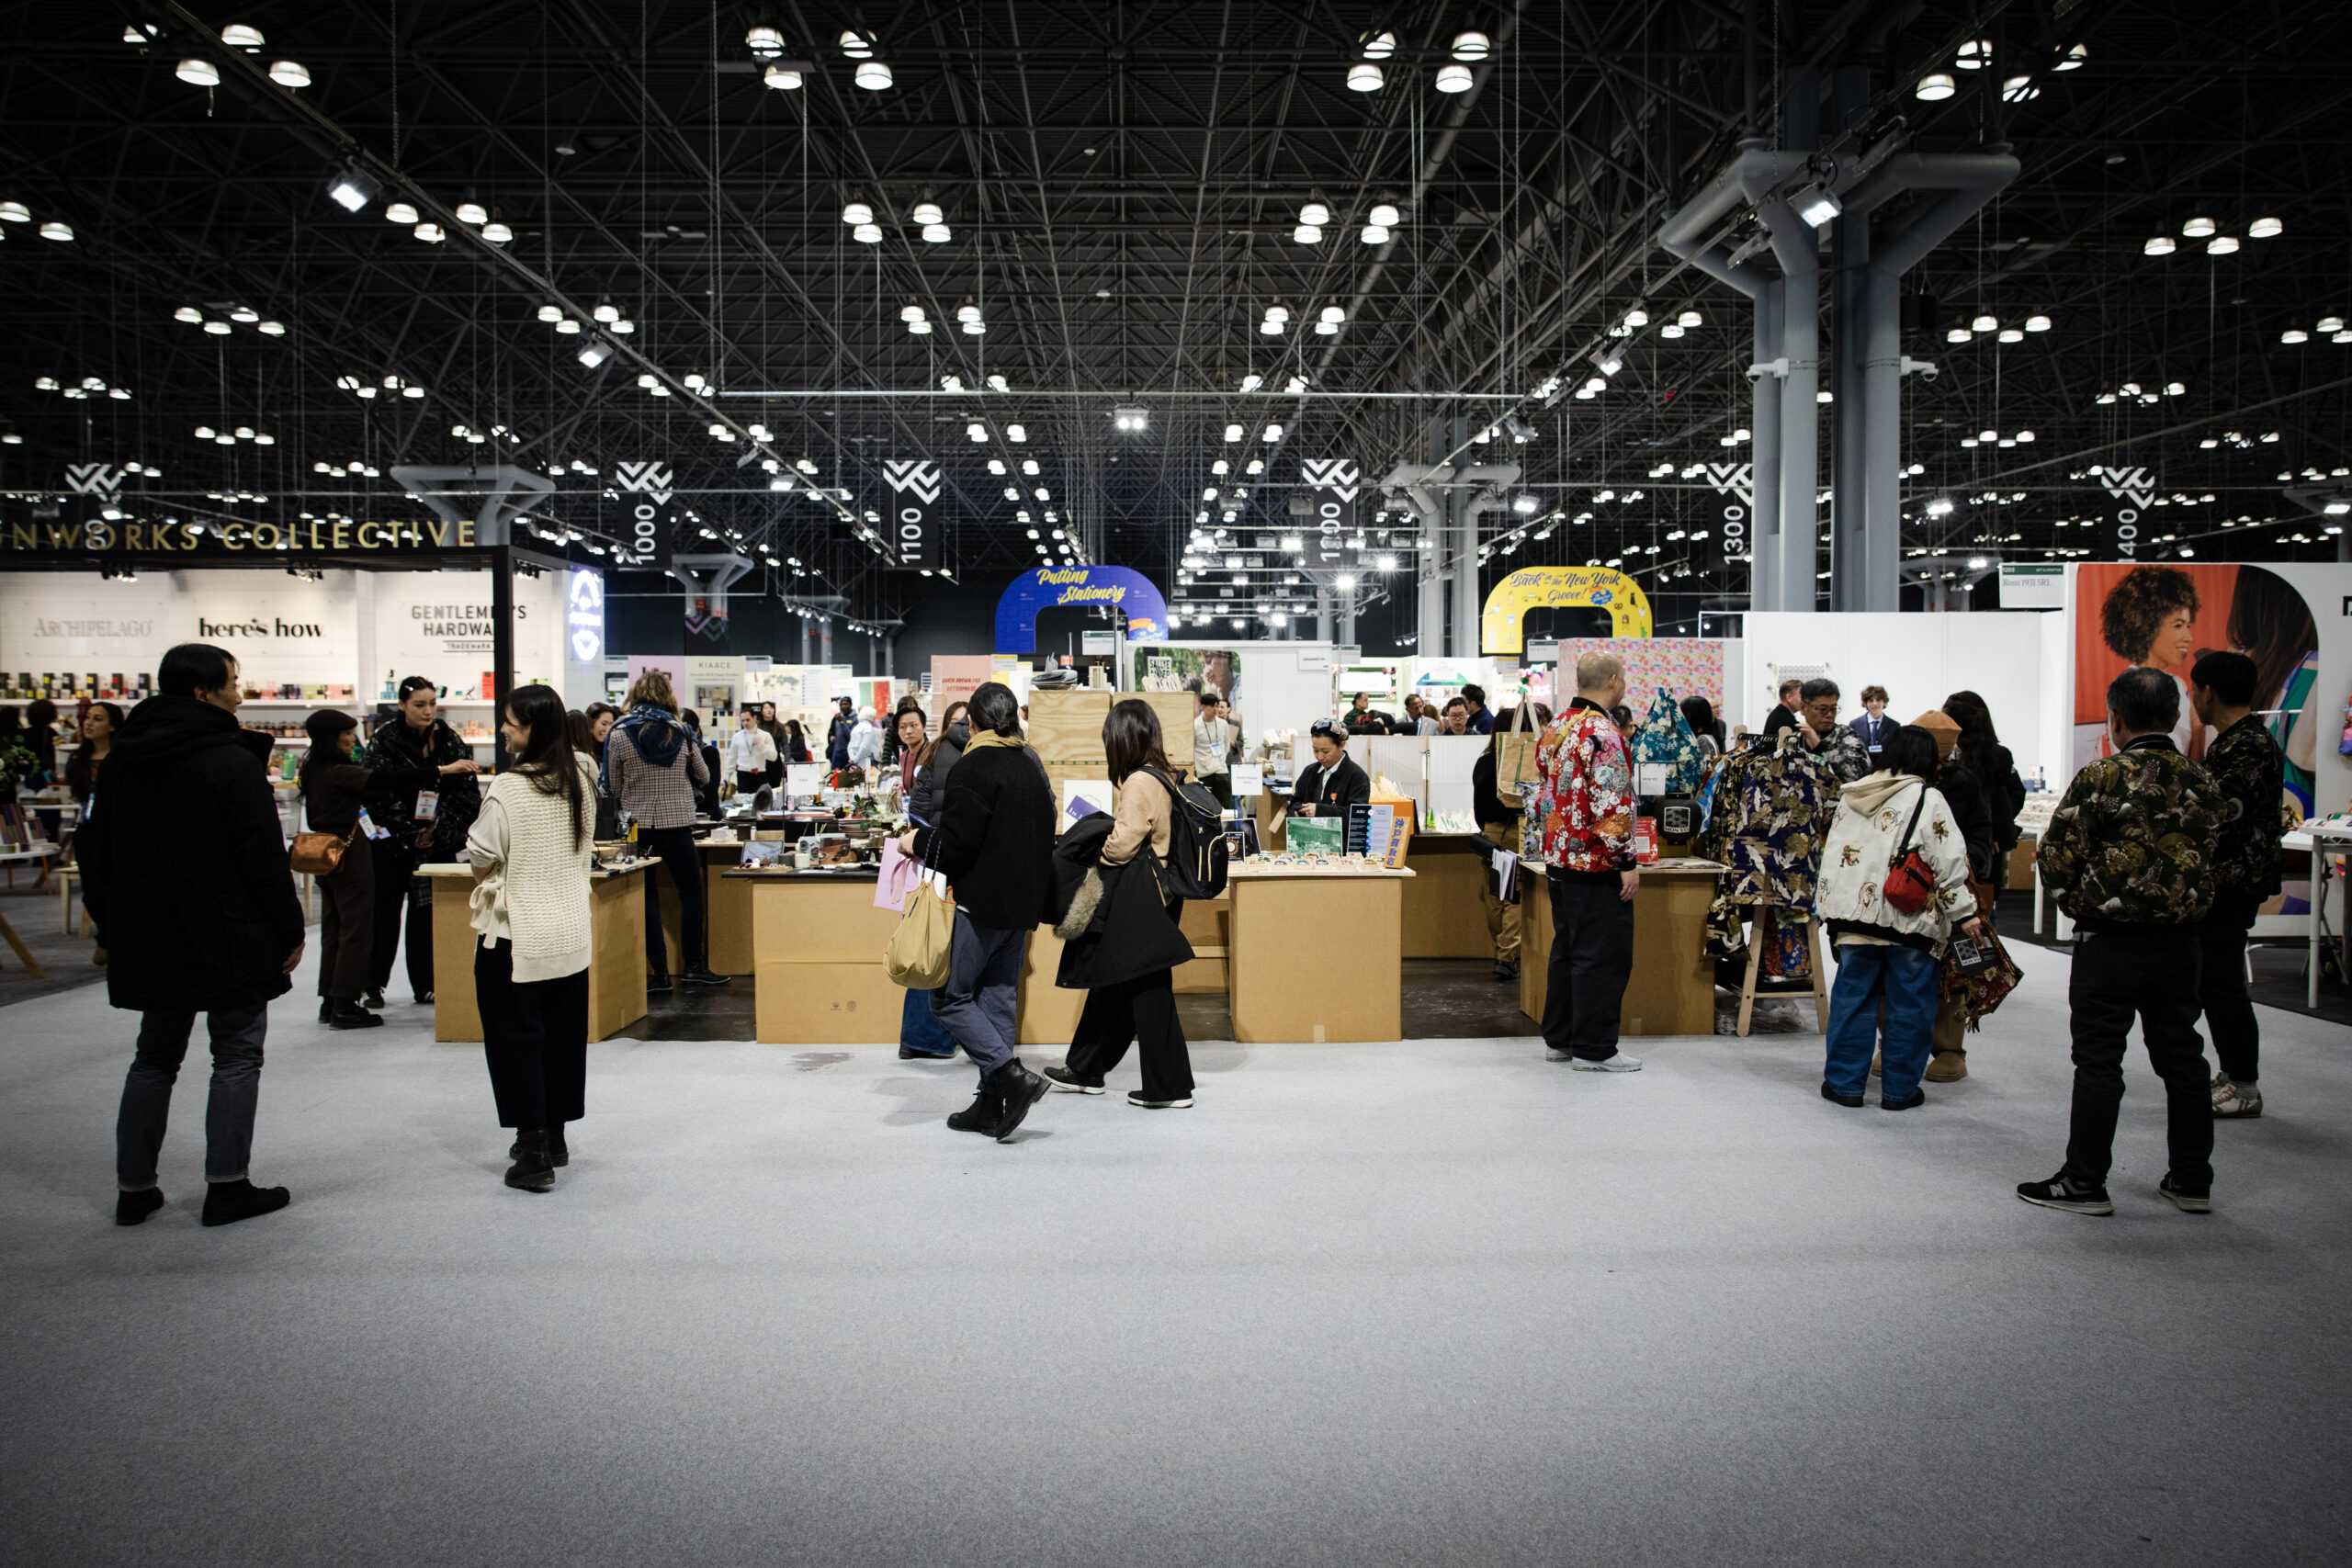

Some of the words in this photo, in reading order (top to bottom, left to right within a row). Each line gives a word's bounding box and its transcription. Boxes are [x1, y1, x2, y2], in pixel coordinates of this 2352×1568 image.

[0, 522, 198, 550] NWORKS
[222, 521, 475, 550] COLLECTIVE
[634, 504, 655, 565] 1000
[900, 508, 922, 563] 1100
[1320, 502, 1340, 561] 100
[1724, 505, 1745, 564] 1300
[1036, 567, 1089, 585] Putting
[1510, 572, 1545, 588] Back
[1563, 572, 1590, 588] New
[1590, 571, 1621, 588] York
[1057, 584, 1126, 605] Stationery
[1547, 588, 1588, 604] Groove!
[412, 604, 526, 619] GENTLEM'S
[33, 617, 152, 637] ARCHIPELAGO
[199, 616, 268, 637] here's
[1150, 658, 1170, 670] SALLYE
